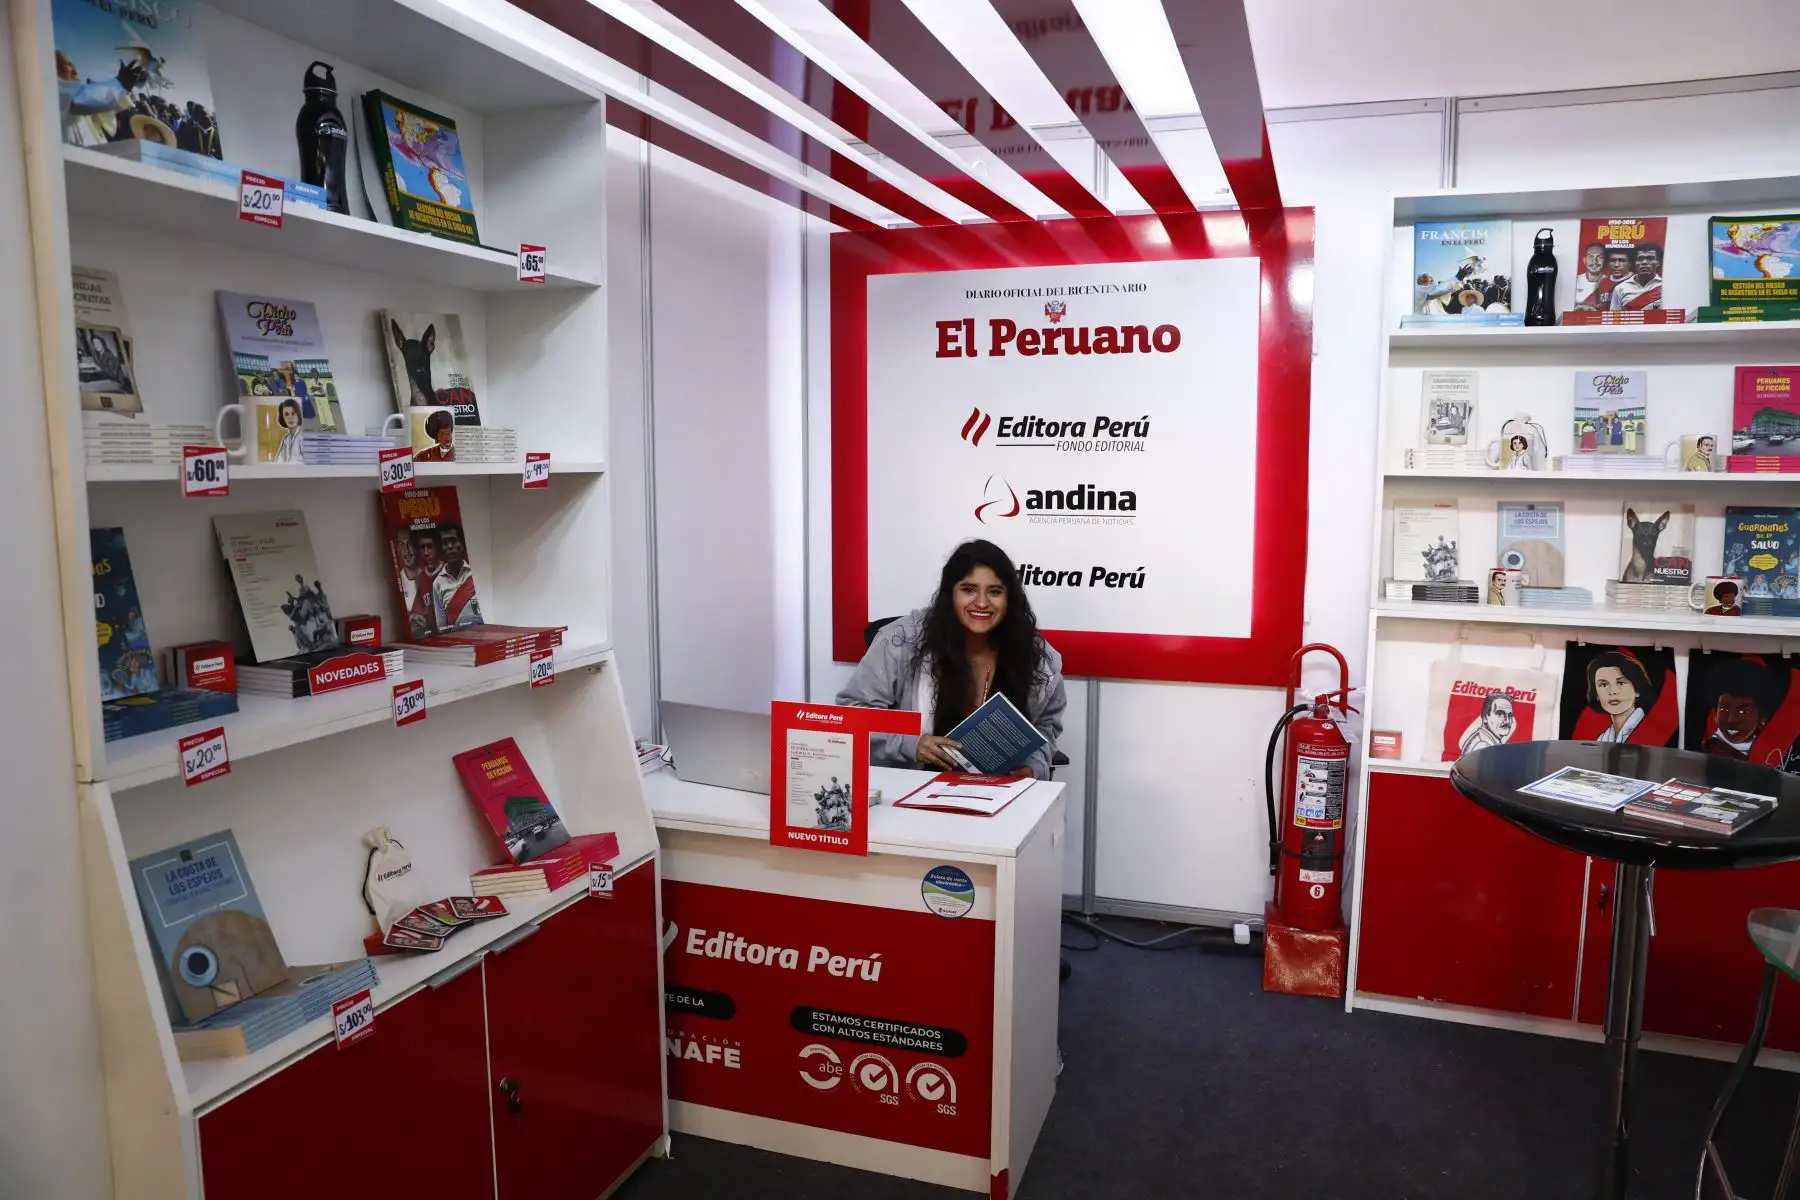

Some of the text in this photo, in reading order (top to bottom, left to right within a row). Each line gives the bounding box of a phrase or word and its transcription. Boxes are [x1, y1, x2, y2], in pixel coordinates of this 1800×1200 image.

[1597, 220, 1646, 240] PERÚ
[965, 282, 1147, 300] DIARIO OFICIAL DEL BICENTENARIO
[935, 318, 1182, 358] El Peruano
[1756, 377, 1791, 385] PERUANOS
[1765, 384, 1791, 392] FICCIÓN
[435, 387, 474, 405] CAN
[453, 404, 475, 415] STRO
[996, 415, 1151, 438] Editora Perú
[1056, 440, 1146, 452] FONDO EDITORIAL
[1025, 483, 1137, 511] andina
[399, 497, 441, 520] PERÚ
[1028, 517, 1057, 525] AGENCIA
[1058, 517, 1091, 525] PERUANA
[1750, 540, 1780, 550] SALUD
[1015, 563, 1146, 589] ditora Perú
[1653, 567, 1689, 576] NUESTRO
[315, 661, 380, 685] NOVEDADES
[1451, 680, 1538, 702] Editora Perú
[805, 711, 828, 721] Editora
[828, 714, 844, 722] Perú
[183, 736, 206, 748] PRECIO
[480, 755, 509, 772] PERUANOS
[486, 764, 514, 780] DE FICCIÓN
[788, 831, 849, 846] NUEVO TÍTULO
[164, 856, 218, 883] LA COSTA DE
[168, 881, 187, 897] LOS
[186, 868, 224, 891] ESPEJOS
[1313, 886, 1321, 897] 6
[685, 927, 883, 982] Editora Perú
[676, 995, 690, 1005] DE
[692, 998, 705, 1007] LA
[812, 1011, 941, 1039] ESTAMOS CERTIFICADOS
[667, 1028, 741, 1047] ORACIÓN
[812, 1023, 943, 1051] CON ALTOS ESTÁNDARES
[665, 1035, 741, 1070] NAFE
[818, 1061, 843, 1076] abe
[880, 1093, 899, 1106] SGS
[937, 1103, 957, 1116] SGS
